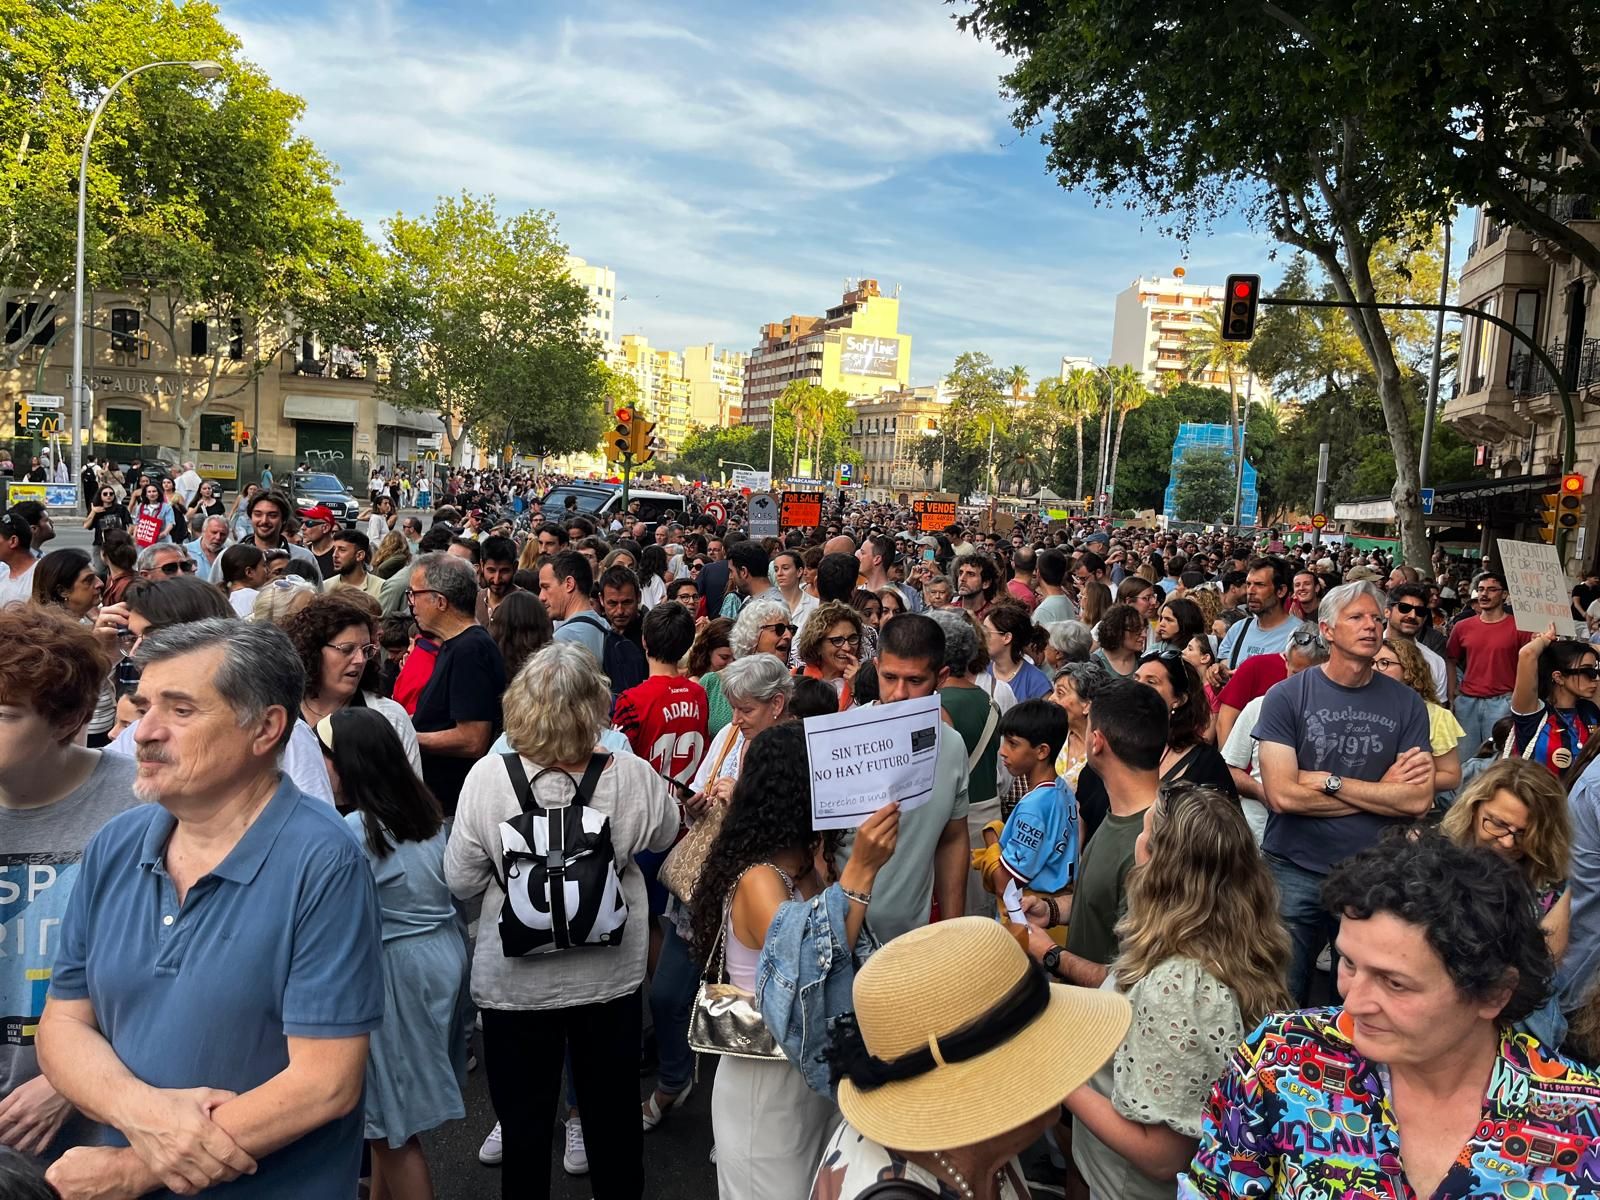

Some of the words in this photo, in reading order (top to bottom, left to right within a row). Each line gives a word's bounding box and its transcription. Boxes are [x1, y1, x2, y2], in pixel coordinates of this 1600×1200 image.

[785, 493, 798, 502] FOR
[800, 493, 819, 502] SALE
[1421, 497, 1432, 506] XI
[914, 502, 924, 512] SE
[927, 502, 955, 513] VENDE
[1316, 705, 1397, 733] Rockaway
[1344, 723, 1371, 733] Beach
[832, 746, 851, 761] SIN
[854, 738, 894, 756] TECHO
[1337, 734, 1383, 755] 1975
[815, 769, 832, 781] NO
[836, 761, 864, 779] HAY
[867, 753, 910, 773] FUTURO
[820, 793, 856, 809] Derecho
[867, 791, 887, 802] una
[1016, 820, 1044, 841] NEXEN
[1017, 831, 1039, 849] TIRE
[1555, 1084, 1582, 1093] PARTY
